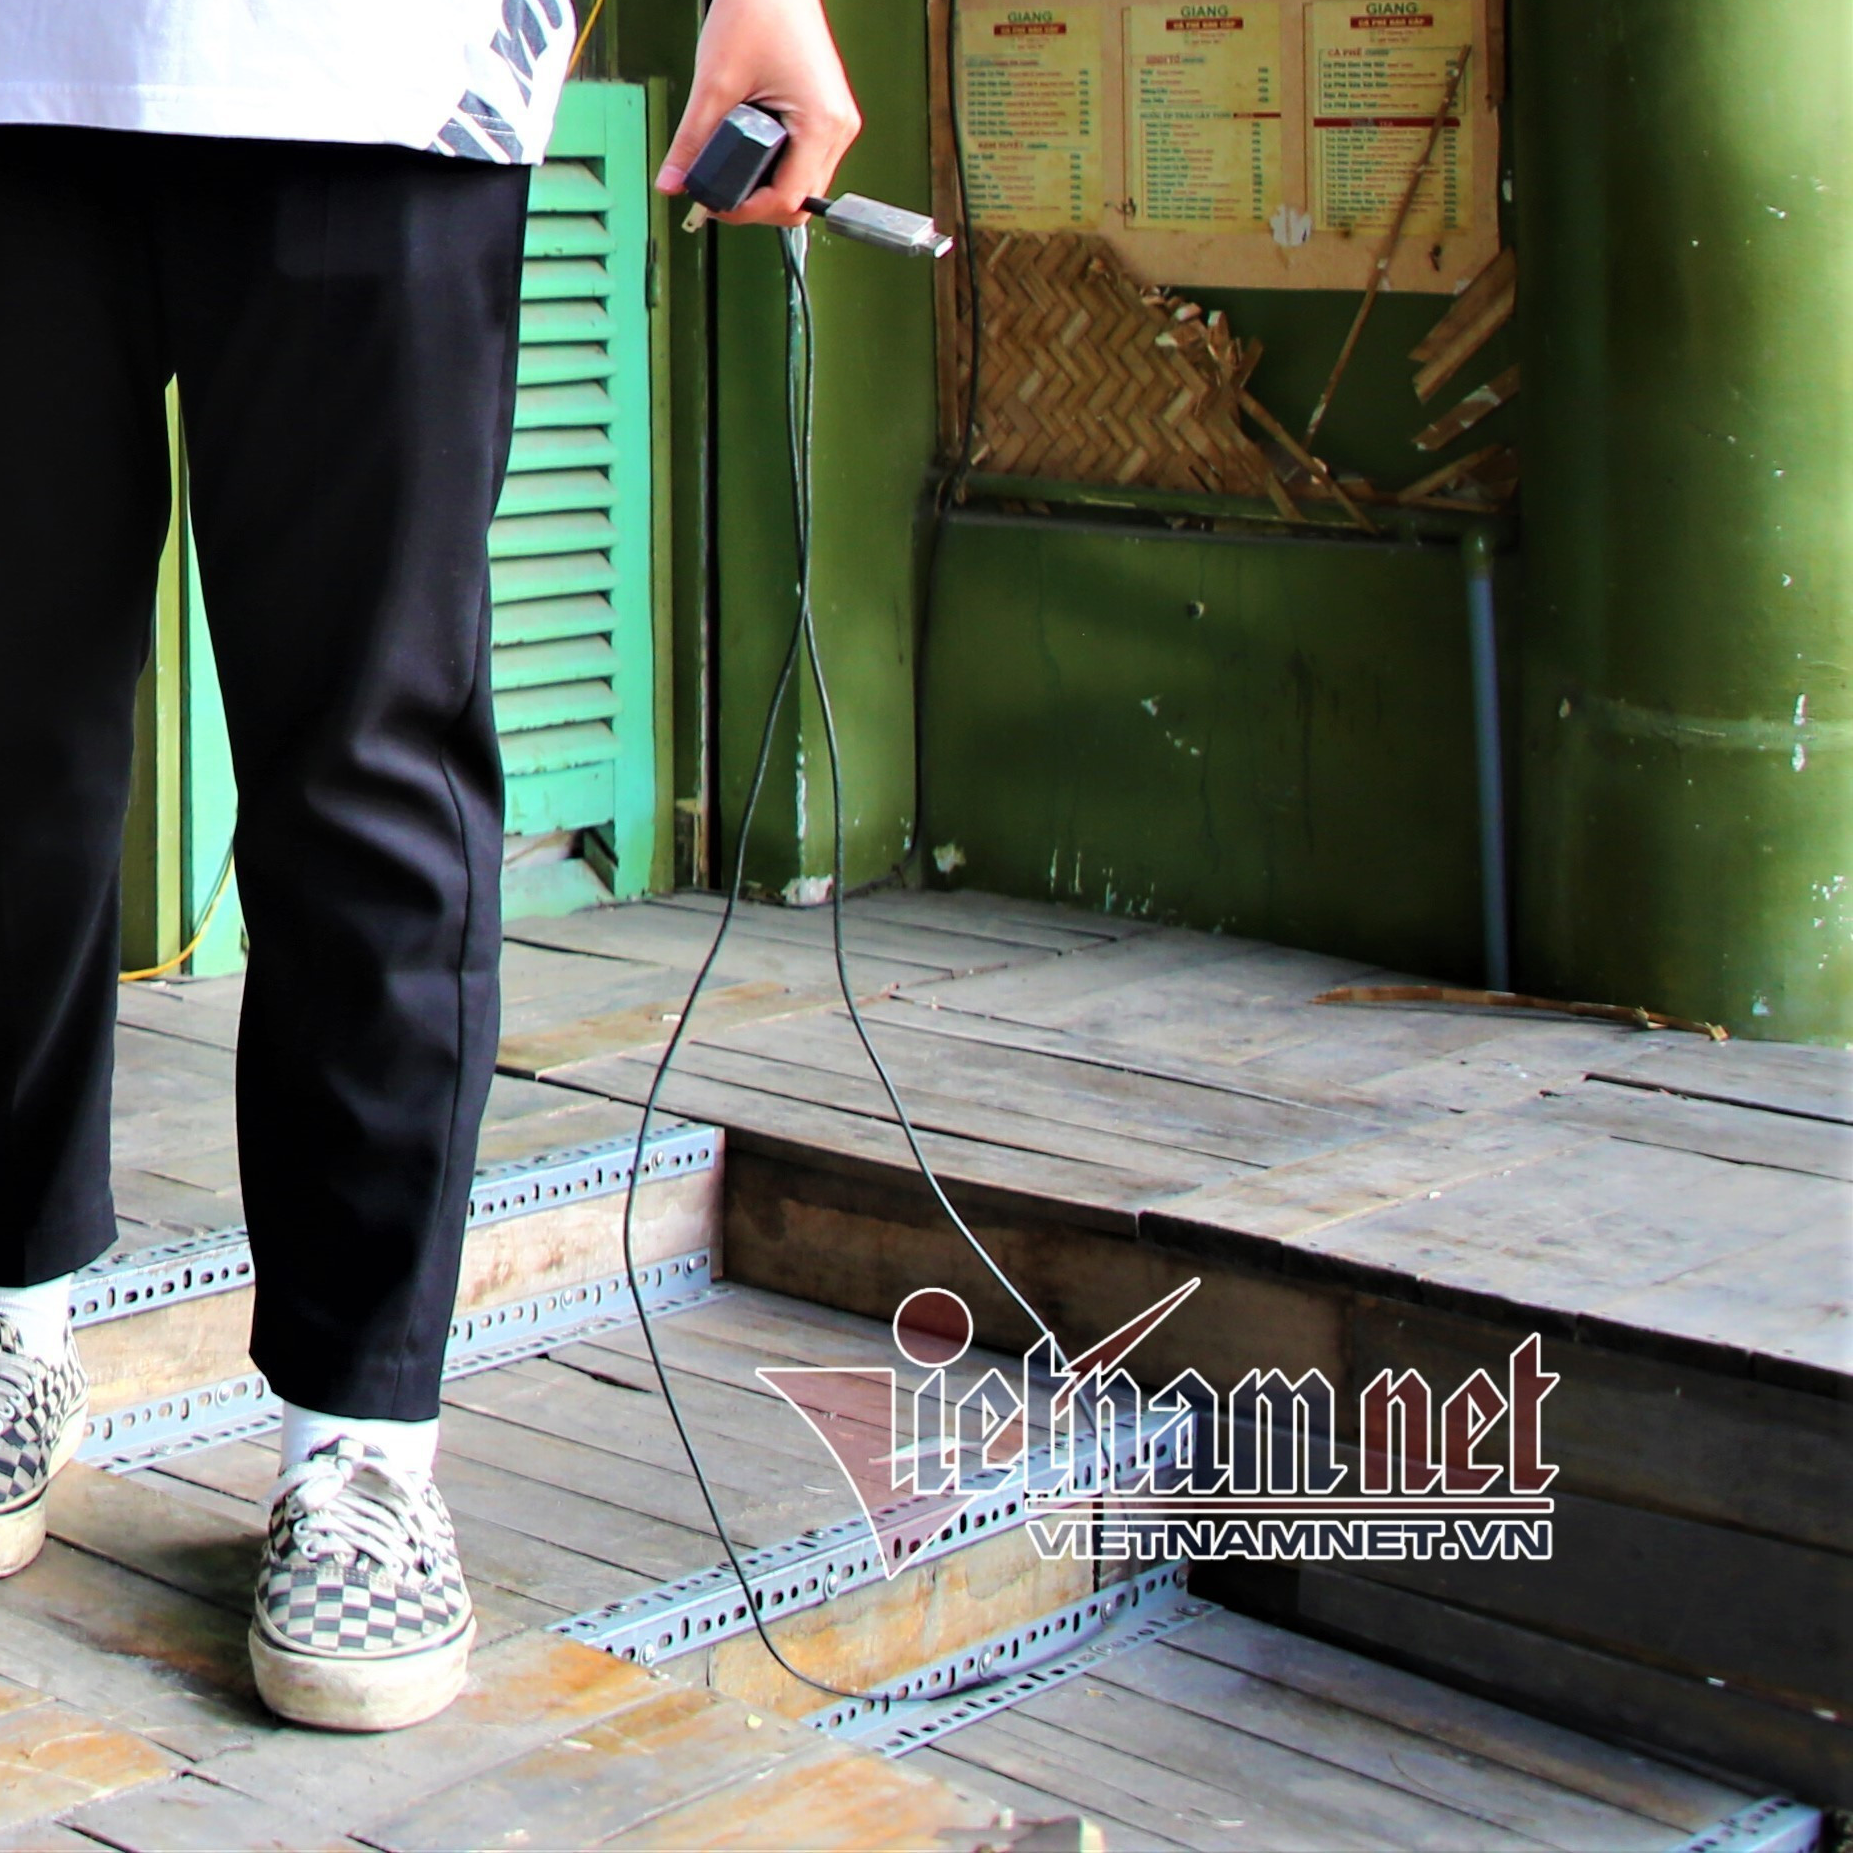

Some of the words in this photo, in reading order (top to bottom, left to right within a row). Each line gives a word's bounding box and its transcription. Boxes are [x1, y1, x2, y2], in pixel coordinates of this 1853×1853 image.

[1180, 5, 1229, 17] GIANG
[1365, 1, 1419, 15] GIANG
[1007, 10, 1053, 23] GIANG
